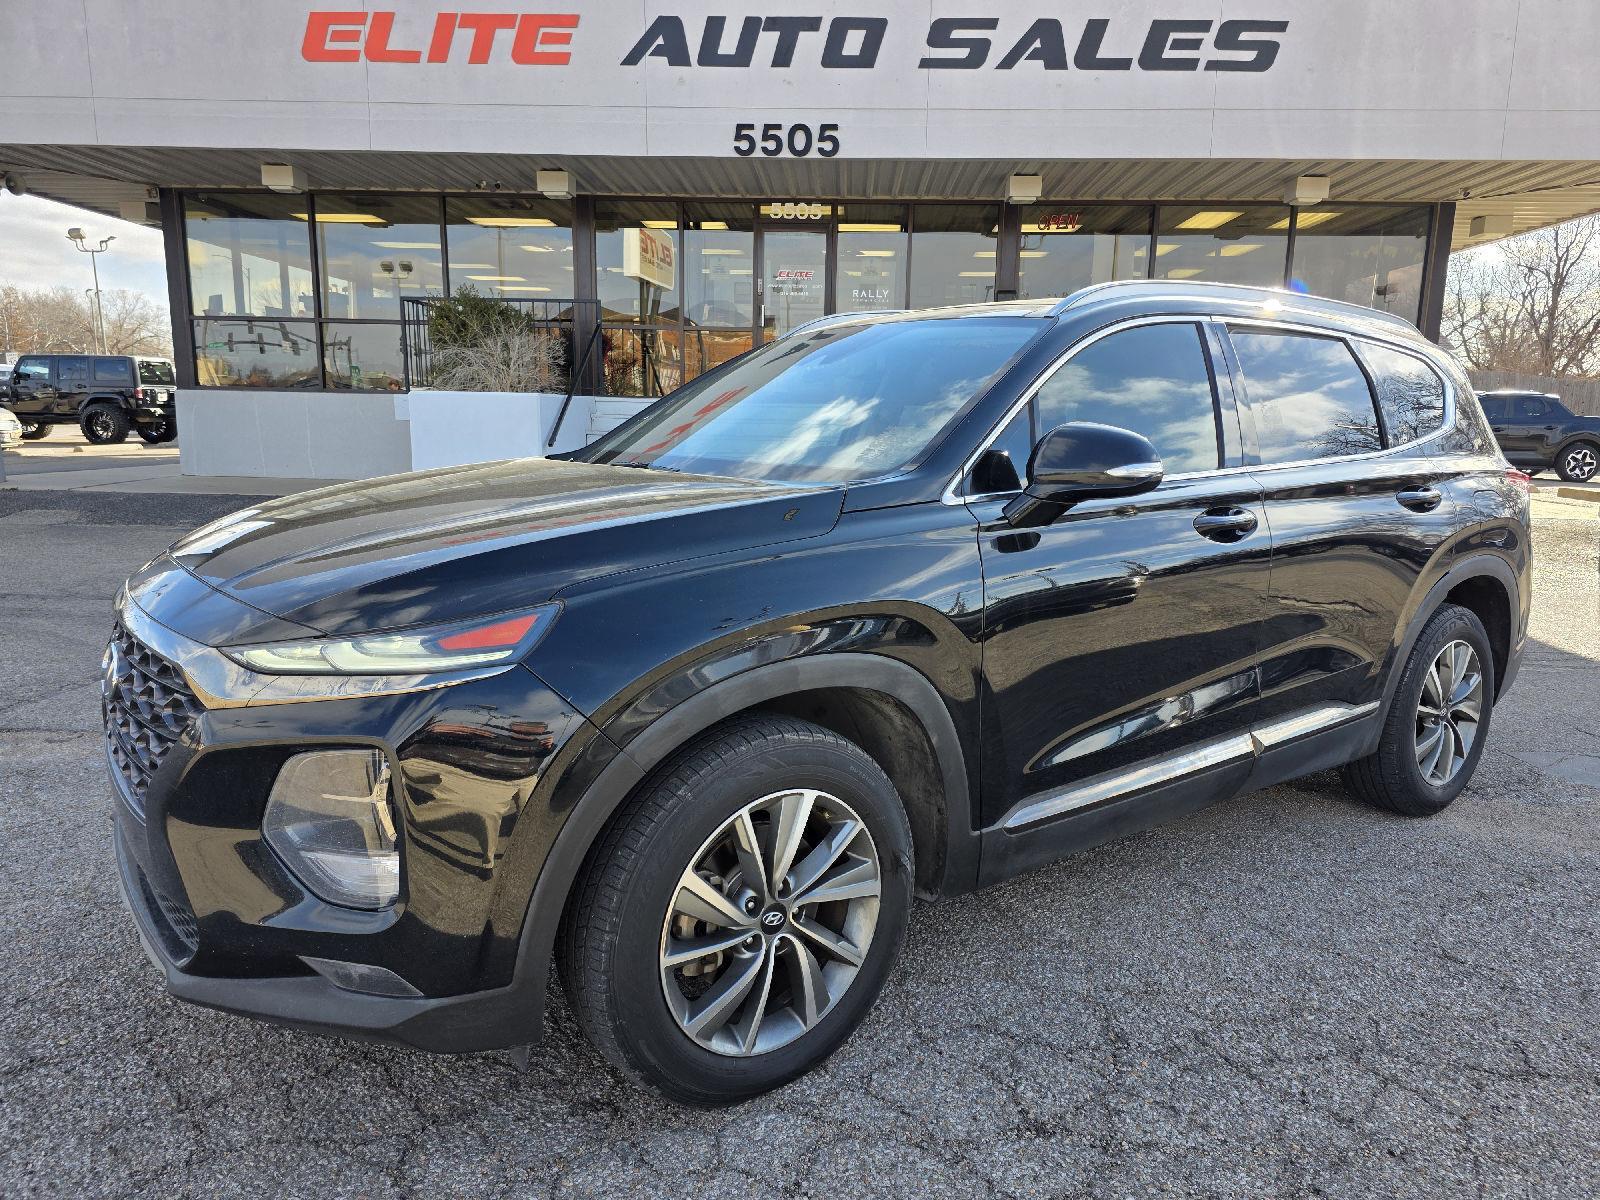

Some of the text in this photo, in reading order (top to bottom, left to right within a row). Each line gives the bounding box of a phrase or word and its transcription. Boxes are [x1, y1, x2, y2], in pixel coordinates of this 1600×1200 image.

[301, 11, 1290, 73] ELITE AUTO SALES
[733, 122, 841, 159] 5505
[769, 202, 823, 220] 5505
[1037, 213, 1080, 231] OPEN
[777, 269, 815, 278] ELITE
[852, 289, 889, 298] RALLY
